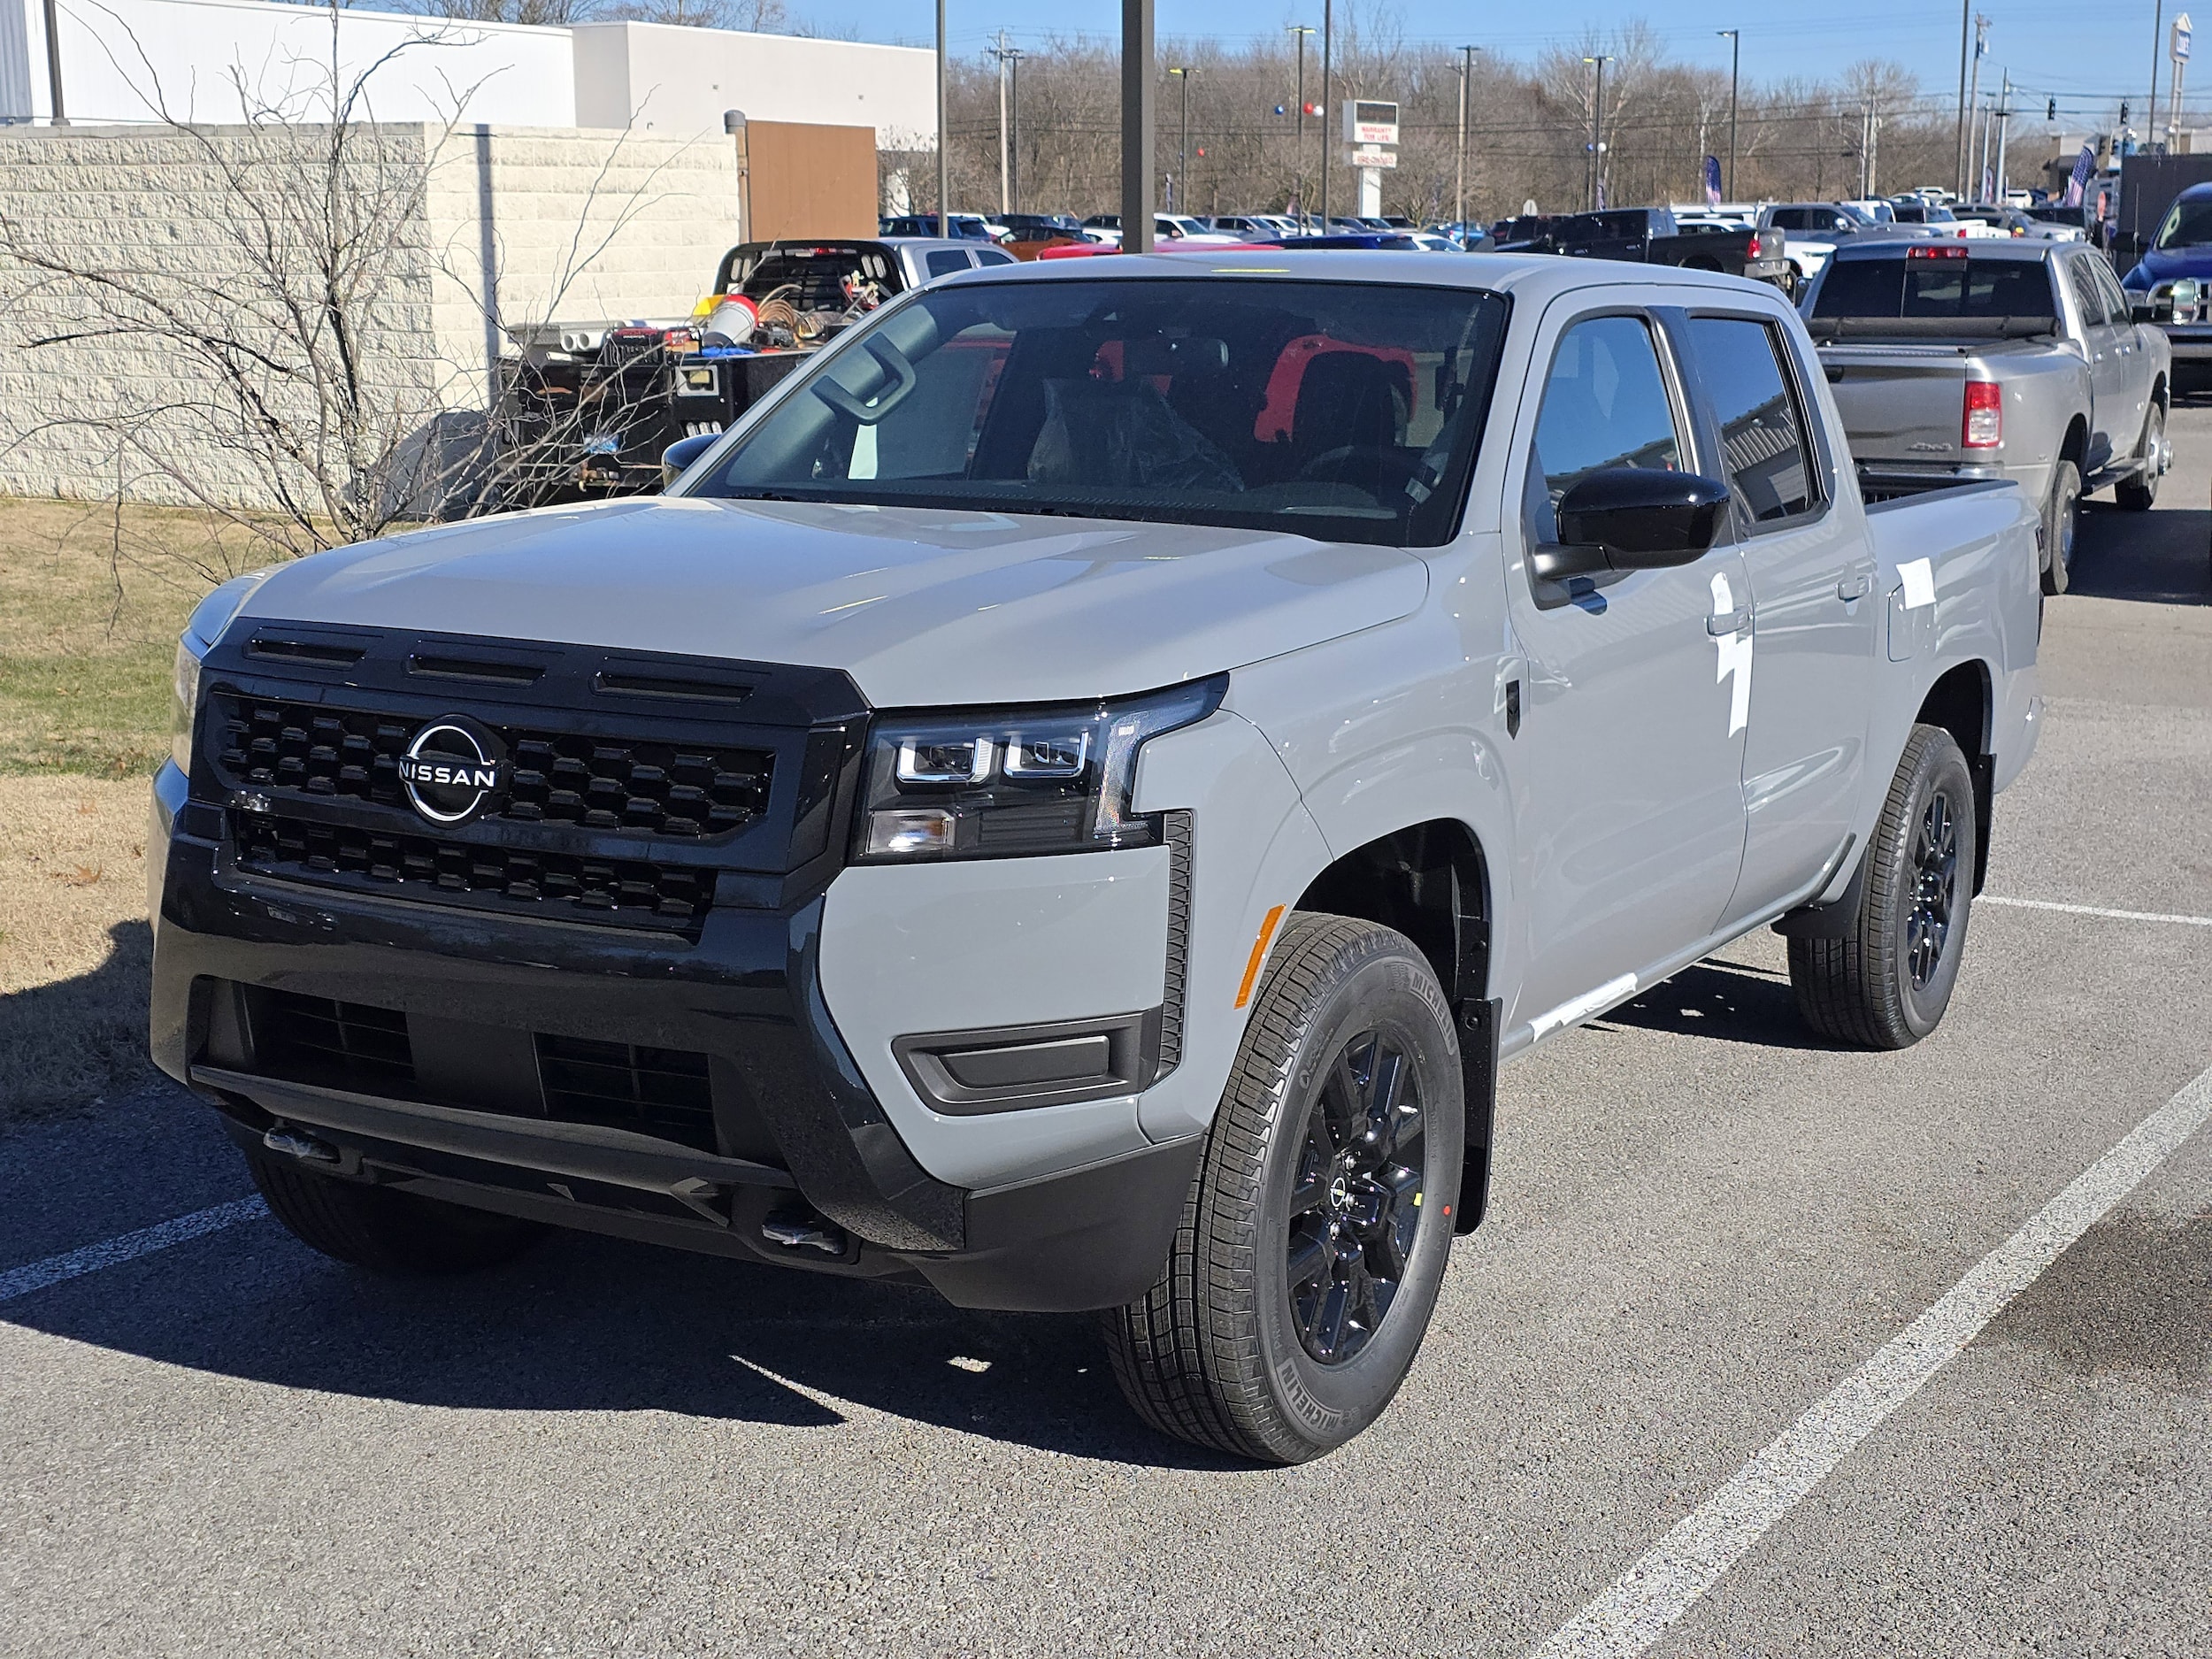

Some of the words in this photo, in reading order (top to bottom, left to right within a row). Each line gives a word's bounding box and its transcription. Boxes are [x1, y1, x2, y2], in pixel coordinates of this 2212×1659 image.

[399, 761, 495, 787] NISSAN
[1411, 972, 1457, 1050] MICHELIN
[1281, 1363, 1340, 1432] MICHELIN
